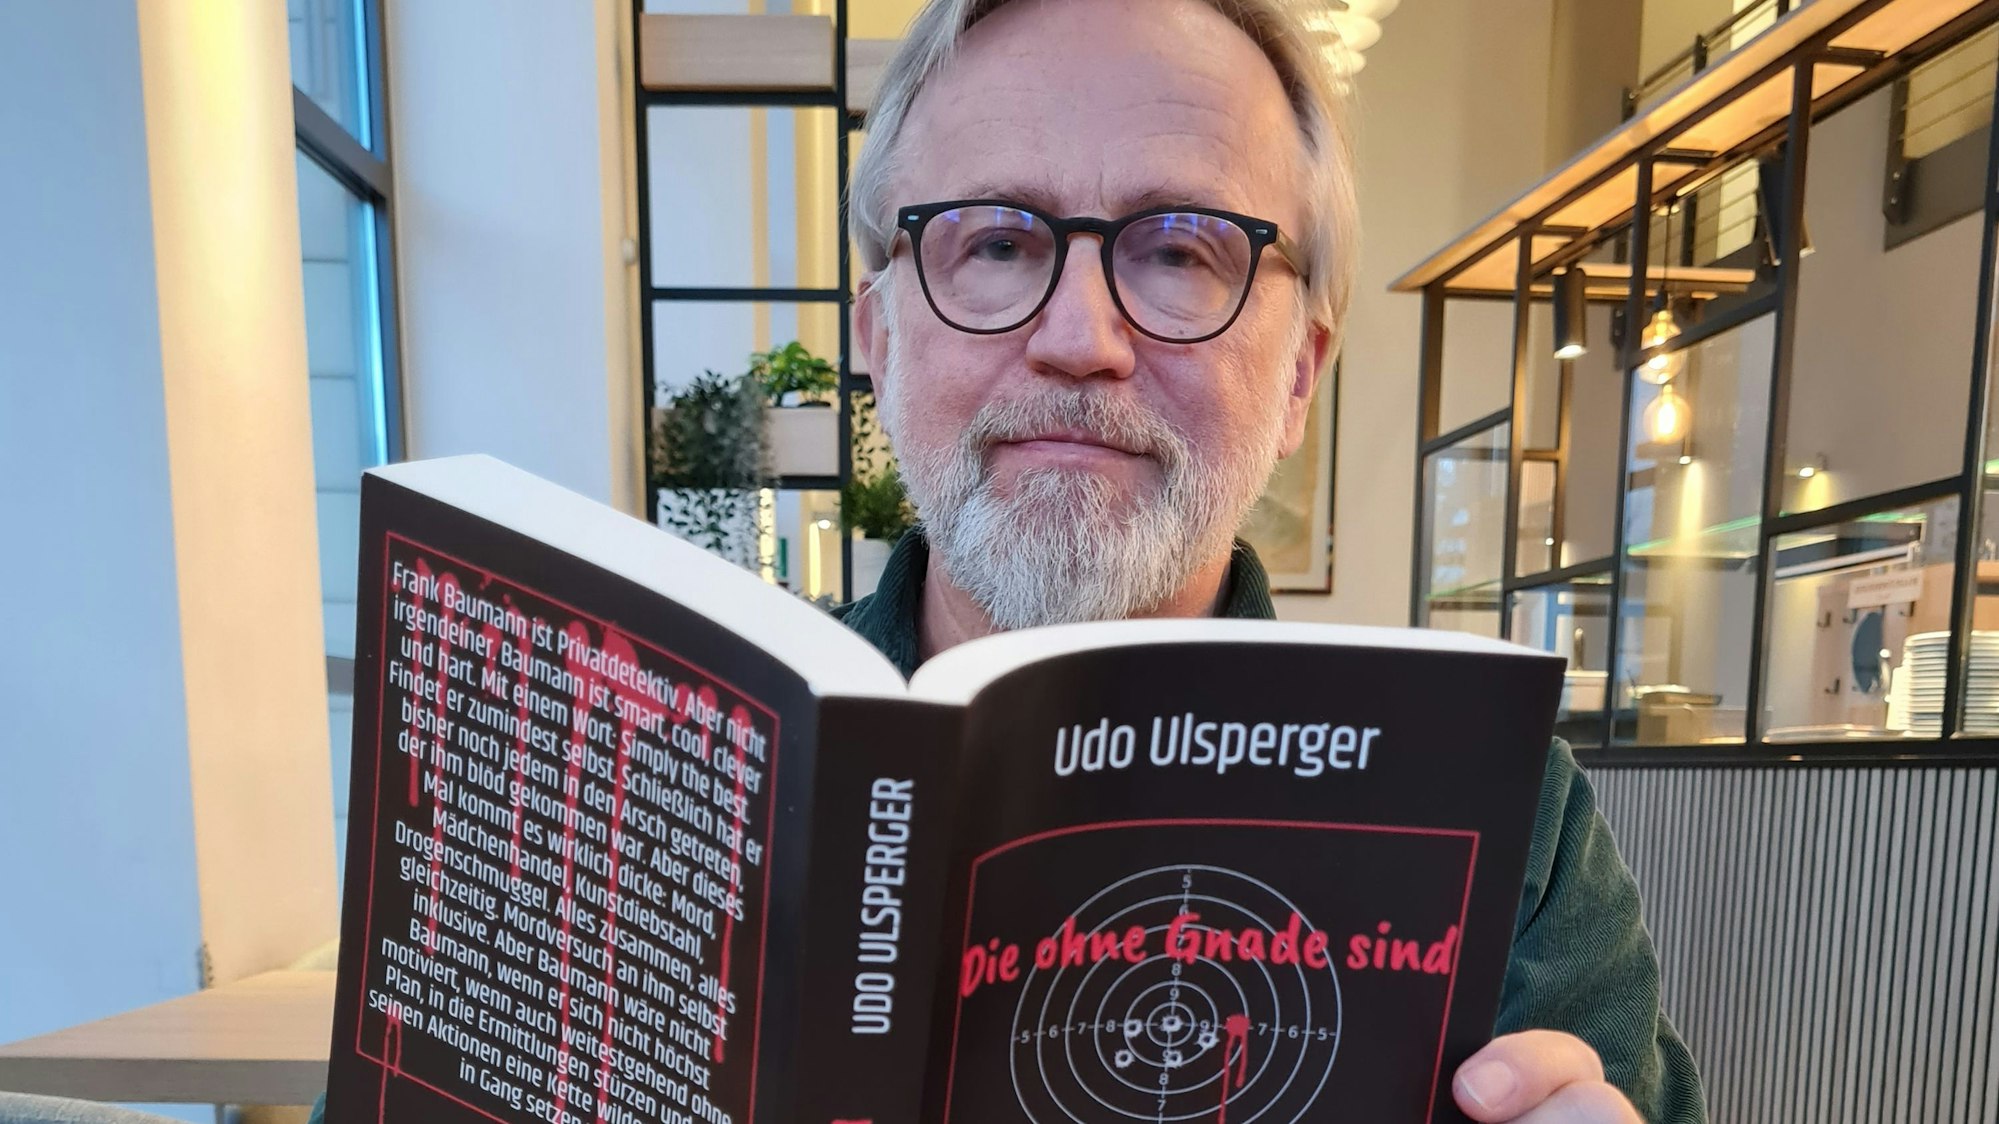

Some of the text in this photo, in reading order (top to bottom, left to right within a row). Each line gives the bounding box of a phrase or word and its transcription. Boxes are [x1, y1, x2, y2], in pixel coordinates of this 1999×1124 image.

[393, 561, 766, 763] Frank Baumann ist Privatdetektiv. Aber nicht
[394, 594, 761, 794] irgendeiner. Baumann ist smart, cool, clever
[401, 636, 750, 825] und hart. Mit einem Wort: Simply the best.
[1054, 712, 1381, 777] Udo Ulsperger
[389, 660, 762, 866] Findet er zumindest selbst. Schließlich hat er
[399, 729, 744, 921] der ihm blöd gekommen war. Aber dieses
[401, 697, 744, 893] bisher noch jedem in den Arsch getreten,
[395, 820, 736, 1014] Drogenschmuggel. Alles zusammen, alles
[424, 770, 716, 940] Mal kommt es wirklich dicke: Mord,
[433, 806, 704, 964] Mädchenhandel, Kunstdiebstahl,
[851, 777, 914, 1034] UDO ULSPERGER
[1182, 874, 1192, 889] 5
[382, 937, 460, 993] motiviert,
[465, 976, 512, 1014] wenn
[515, 1002, 556, 1037] auch
[561, 1023, 688, 1106] weitestgehend
[400, 856, 727, 1040] gleichzeitig. Mordversuch an ihm selbst
[409, 918, 710, 1091] Baumann, wenn er sich nicht höchst
[413, 889, 711, 1061] inklusive. Aber Baumann wäre nicht
[959, 912, 1458, 997] Die ohne Gnade sind
[1020, 1030, 1030, 1044] 5
[1048, 1025, 1058, 1039] 6
[1077, 1022, 1086, 1035] 7
[1106, 1019, 1115, 1033] 8
[1258, 1024, 1267, 1037] 7
[1288, 1026, 1299, 1040] 6
[1318, 1028, 1328, 1041] 5
[1170, 987, 1180, 1000] 9
[1171, 963, 1181, 976] 8
[369, 989, 642, 1124] seinen Aktionen eine Kette wild
[386, 965, 424, 1004] Plan,
[429, 984, 444, 1010] in
[448, 996, 475, 1025] die
[478, 1009, 589, 1082] Ermittlungen
[593, 1068, 656, 1117] stürzen
[459, 1057, 475, 1084] in
[480, 1069, 523, 1110] Gang
[1158, 1099, 1166, 1112] 7
[1159, 1073, 1169, 1086] 8
